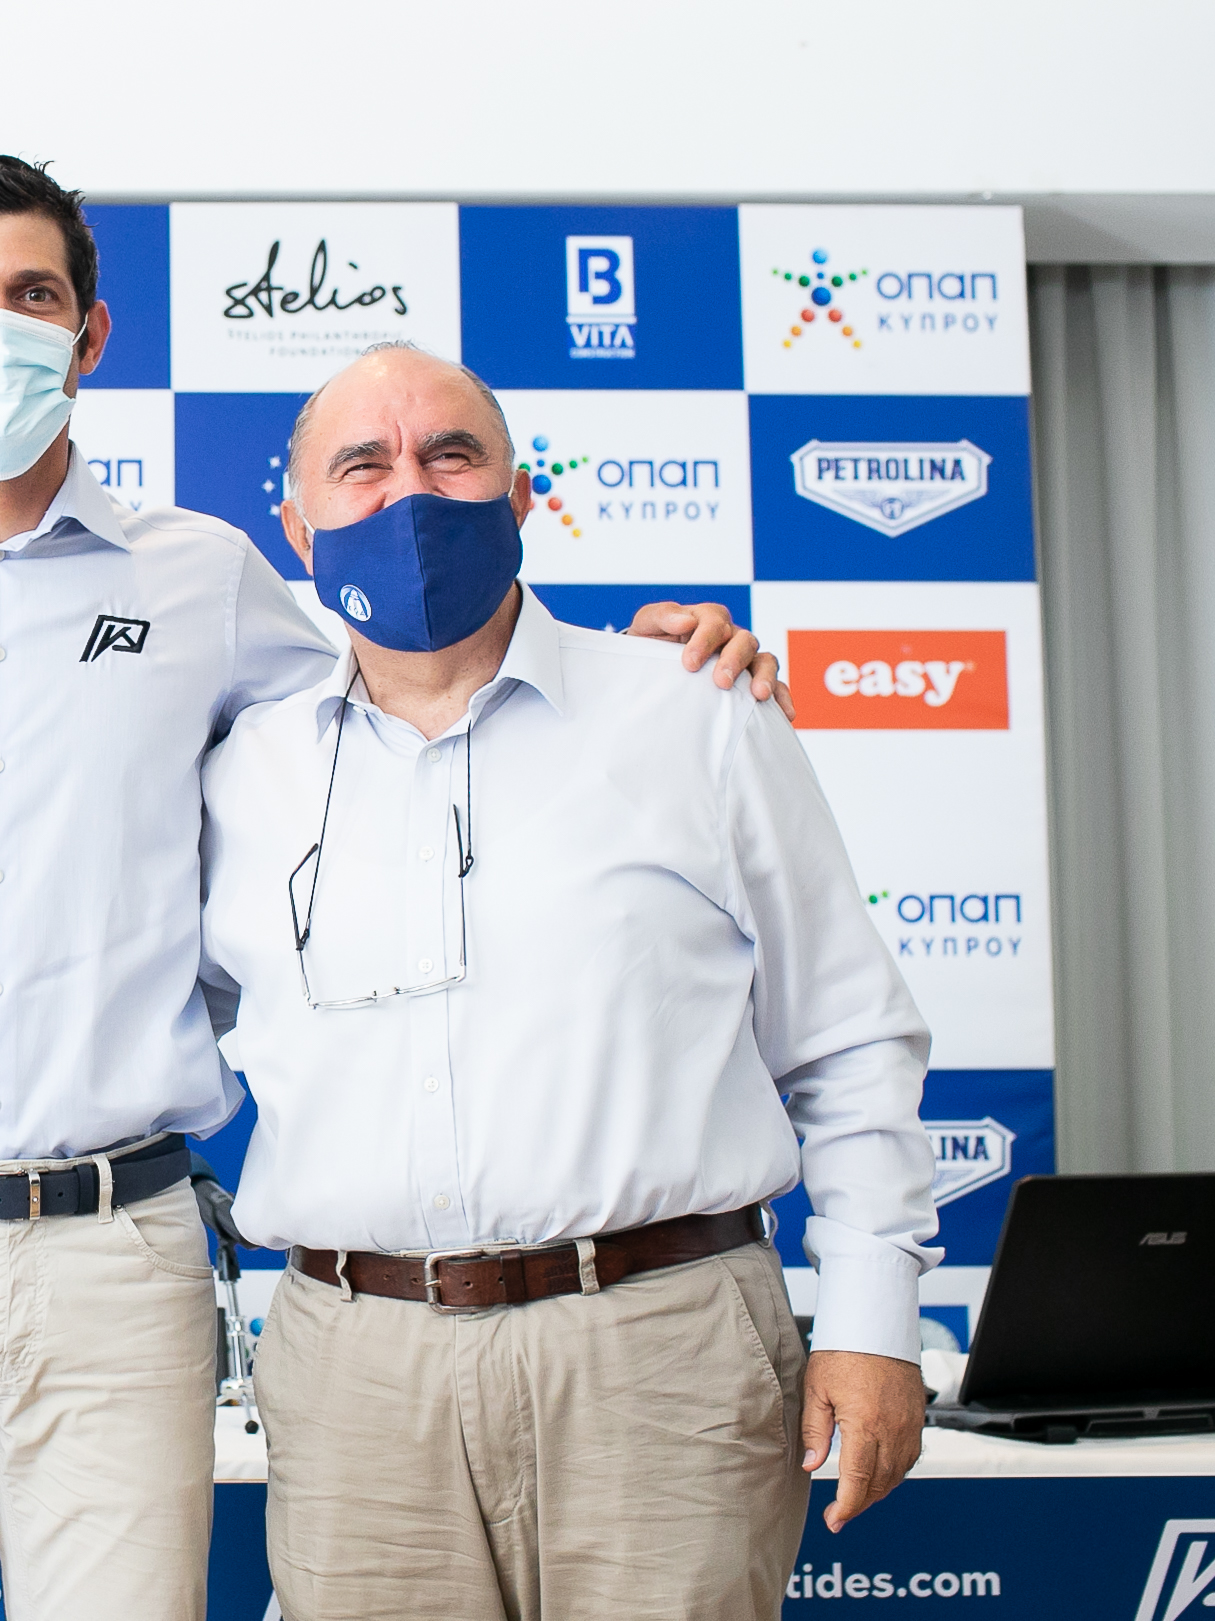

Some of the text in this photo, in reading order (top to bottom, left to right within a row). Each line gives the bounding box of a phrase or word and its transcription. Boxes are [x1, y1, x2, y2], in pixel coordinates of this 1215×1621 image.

[224, 239, 407, 318] stelios
[878, 313, 997, 332] ΚΥΠΡΟΥ
[570, 324, 634, 348] VITA
[817, 457, 965, 482] PETROLINA
[599, 501, 718, 520] ΚΥΠΡΟΥ
[899, 937, 1022, 957] ΚΥΠΡΟΥ
[1139, 1232, 1188, 1246] ASUS
[786, 1562, 1001, 1599] tides.com
